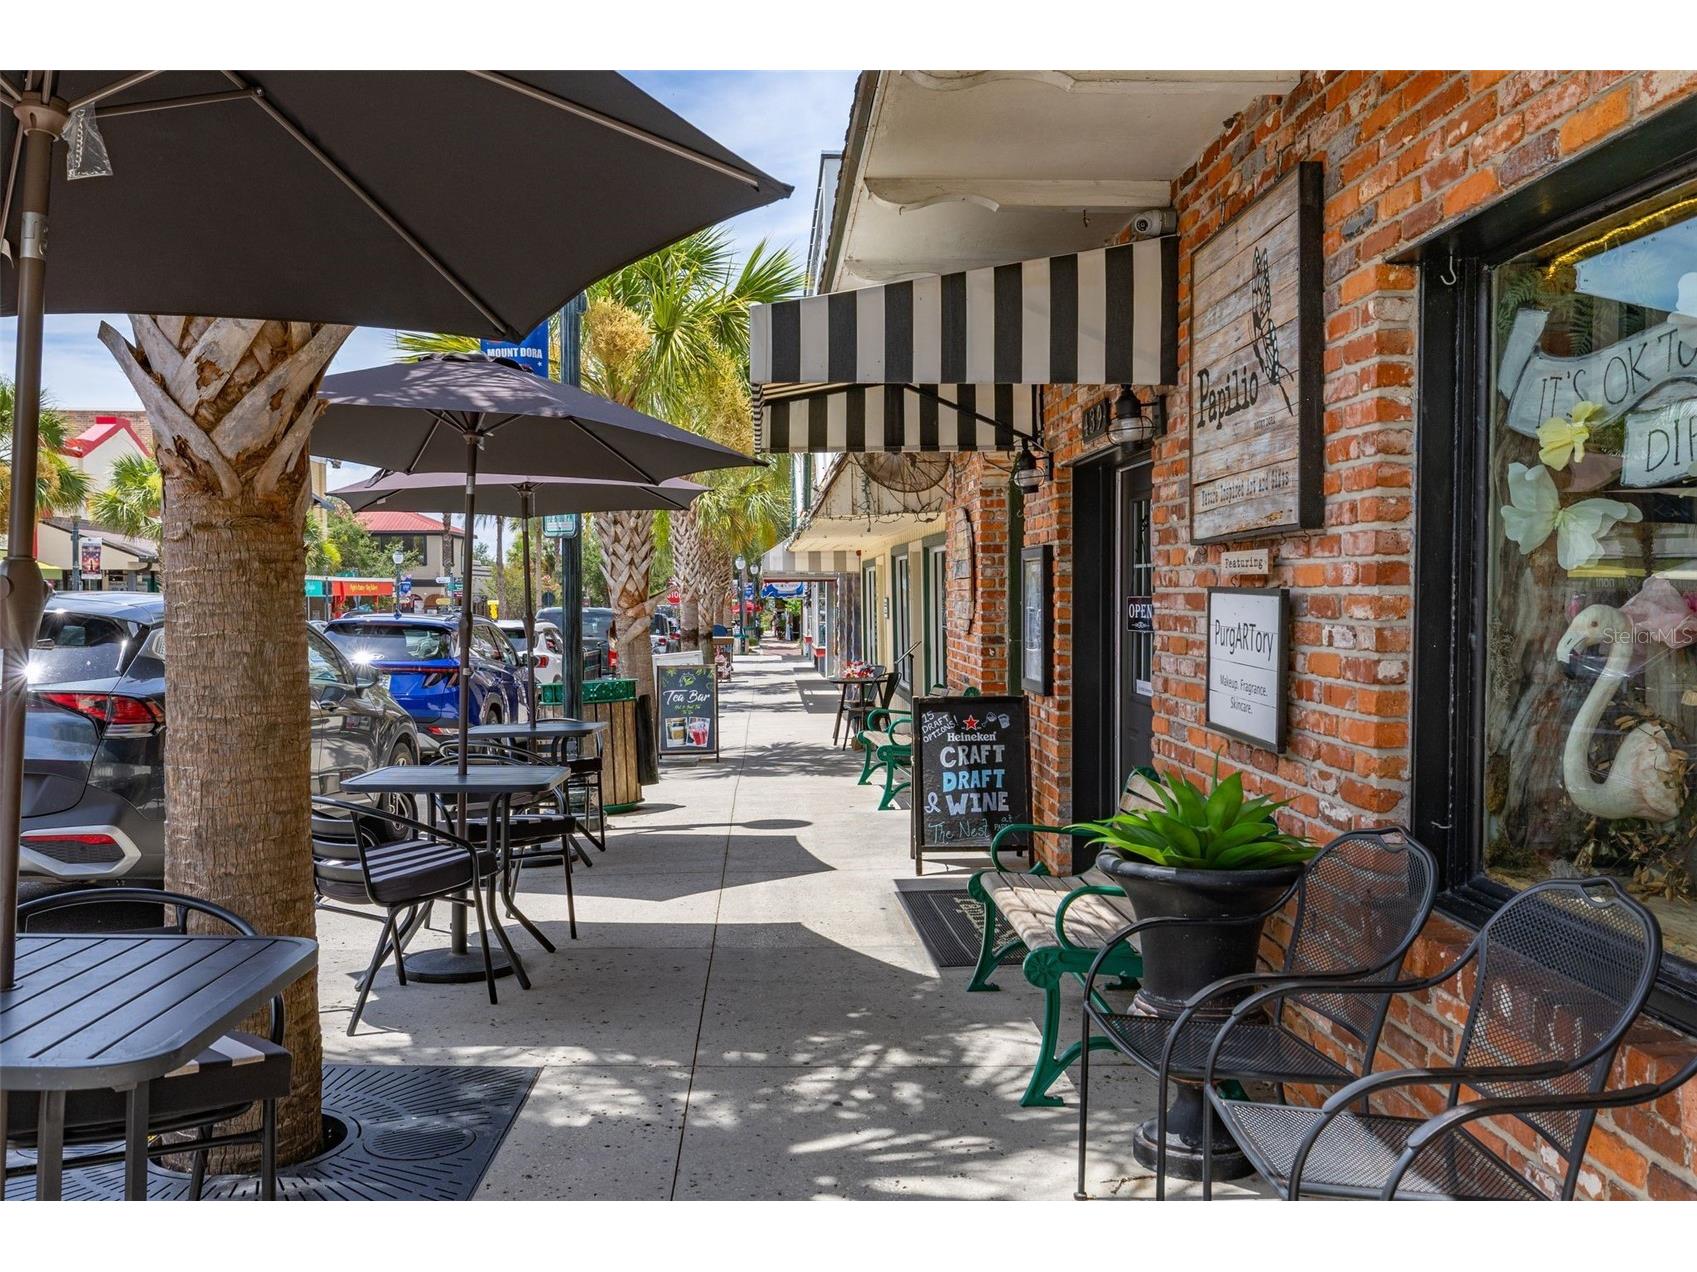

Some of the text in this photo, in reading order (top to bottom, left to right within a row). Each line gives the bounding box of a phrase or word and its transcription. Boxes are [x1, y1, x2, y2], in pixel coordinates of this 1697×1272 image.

[487, 348, 543, 359] MOUNT DORA
[1603, 342, 1651, 405] OK
[1197, 365, 1259, 431] Papilio
[1224, 556, 1264, 570] Featuring
[1128, 603, 1153, 619] OPEN
[1215, 619, 1274, 662] PurgARTory
[662, 689, 711, 706] Tea Bar
[921, 714, 949, 734] DRAFT
[947, 732, 996, 742] Heineken
[939, 744, 1006, 768] CRAFT
[942, 768, 1006, 793] DRAFT
[945, 791, 1010, 816] WINE
[928, 818, 990, 845] The Nest
